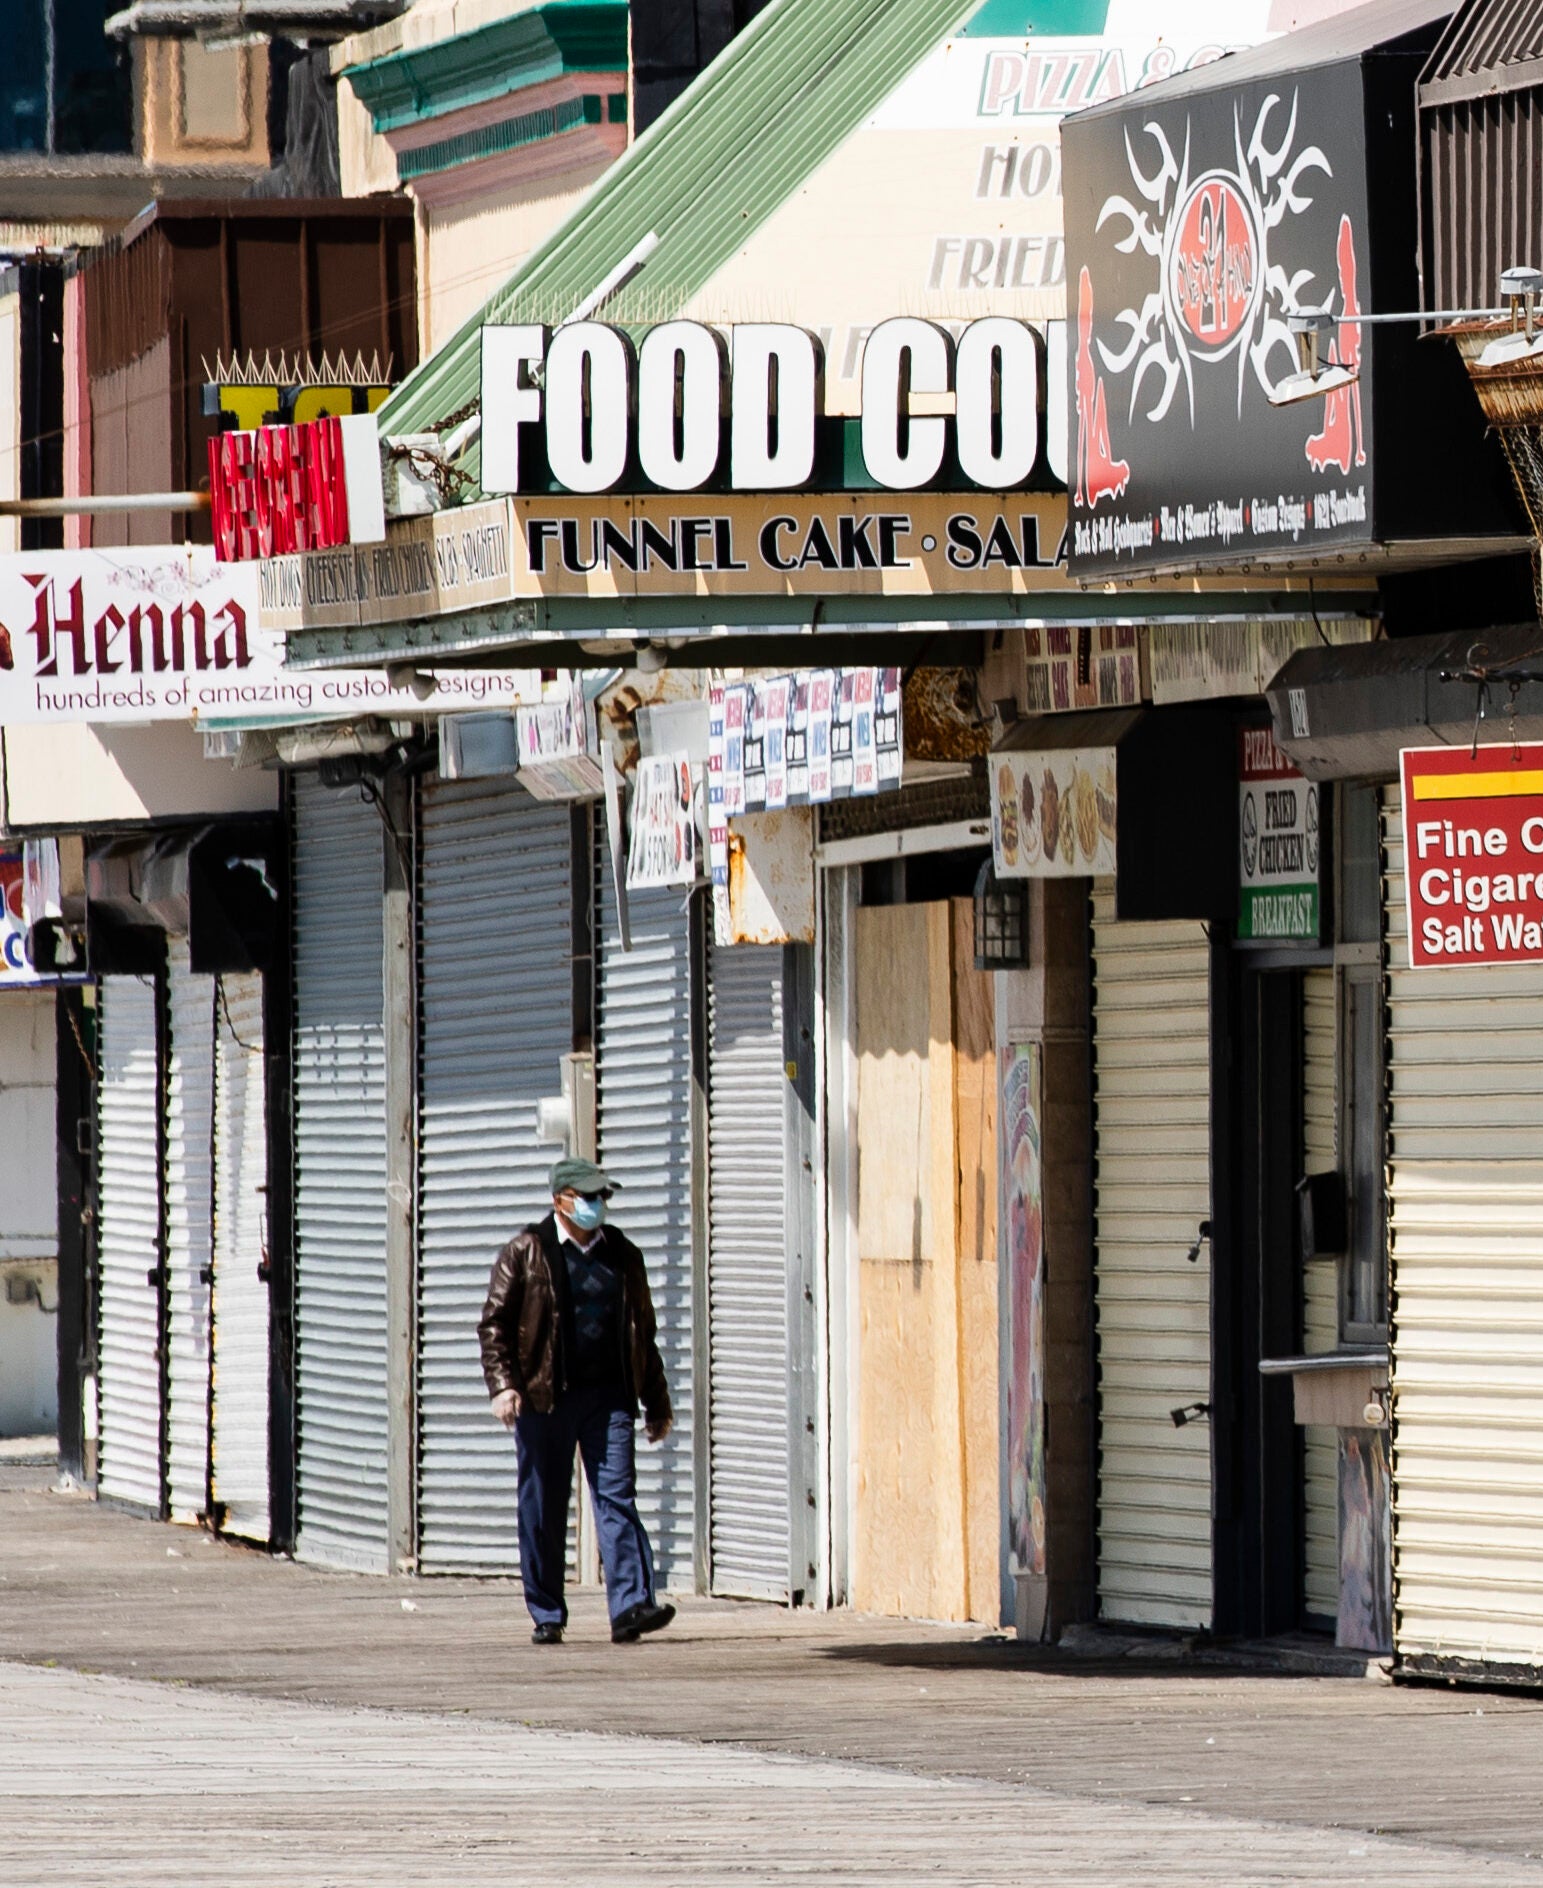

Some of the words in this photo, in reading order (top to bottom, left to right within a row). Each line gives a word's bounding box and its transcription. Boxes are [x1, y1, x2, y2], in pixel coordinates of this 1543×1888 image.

[977, 49, 1128, 116] PIZZA
[929, 237, 1066, 289] FRIED
[481, 319, 824, 494] FOOD
[861, 316, 1067, 490] CO
[526, 517, 749, 575] FUNNEL
[759, 514, 913, 570] CAKE
[21, 573, 254, 678] Henna
[36, 679, 156, 711] hundreds
[165, 675, 192, 707] of
[199, 674, 314, 708] amazing
[437, 673, 515, 701] esigns
[1244, 729, 1275, 771] PIZZA
[1265, 790, 1297, 830] FRIED
[1259, 833, 1304, 876] CHICKEN
[1416, 820, 1509, 859] Fine
[1252, 893, 1312, 937] BREAKFAST
[1422, 915, 1485, 955] Salt
